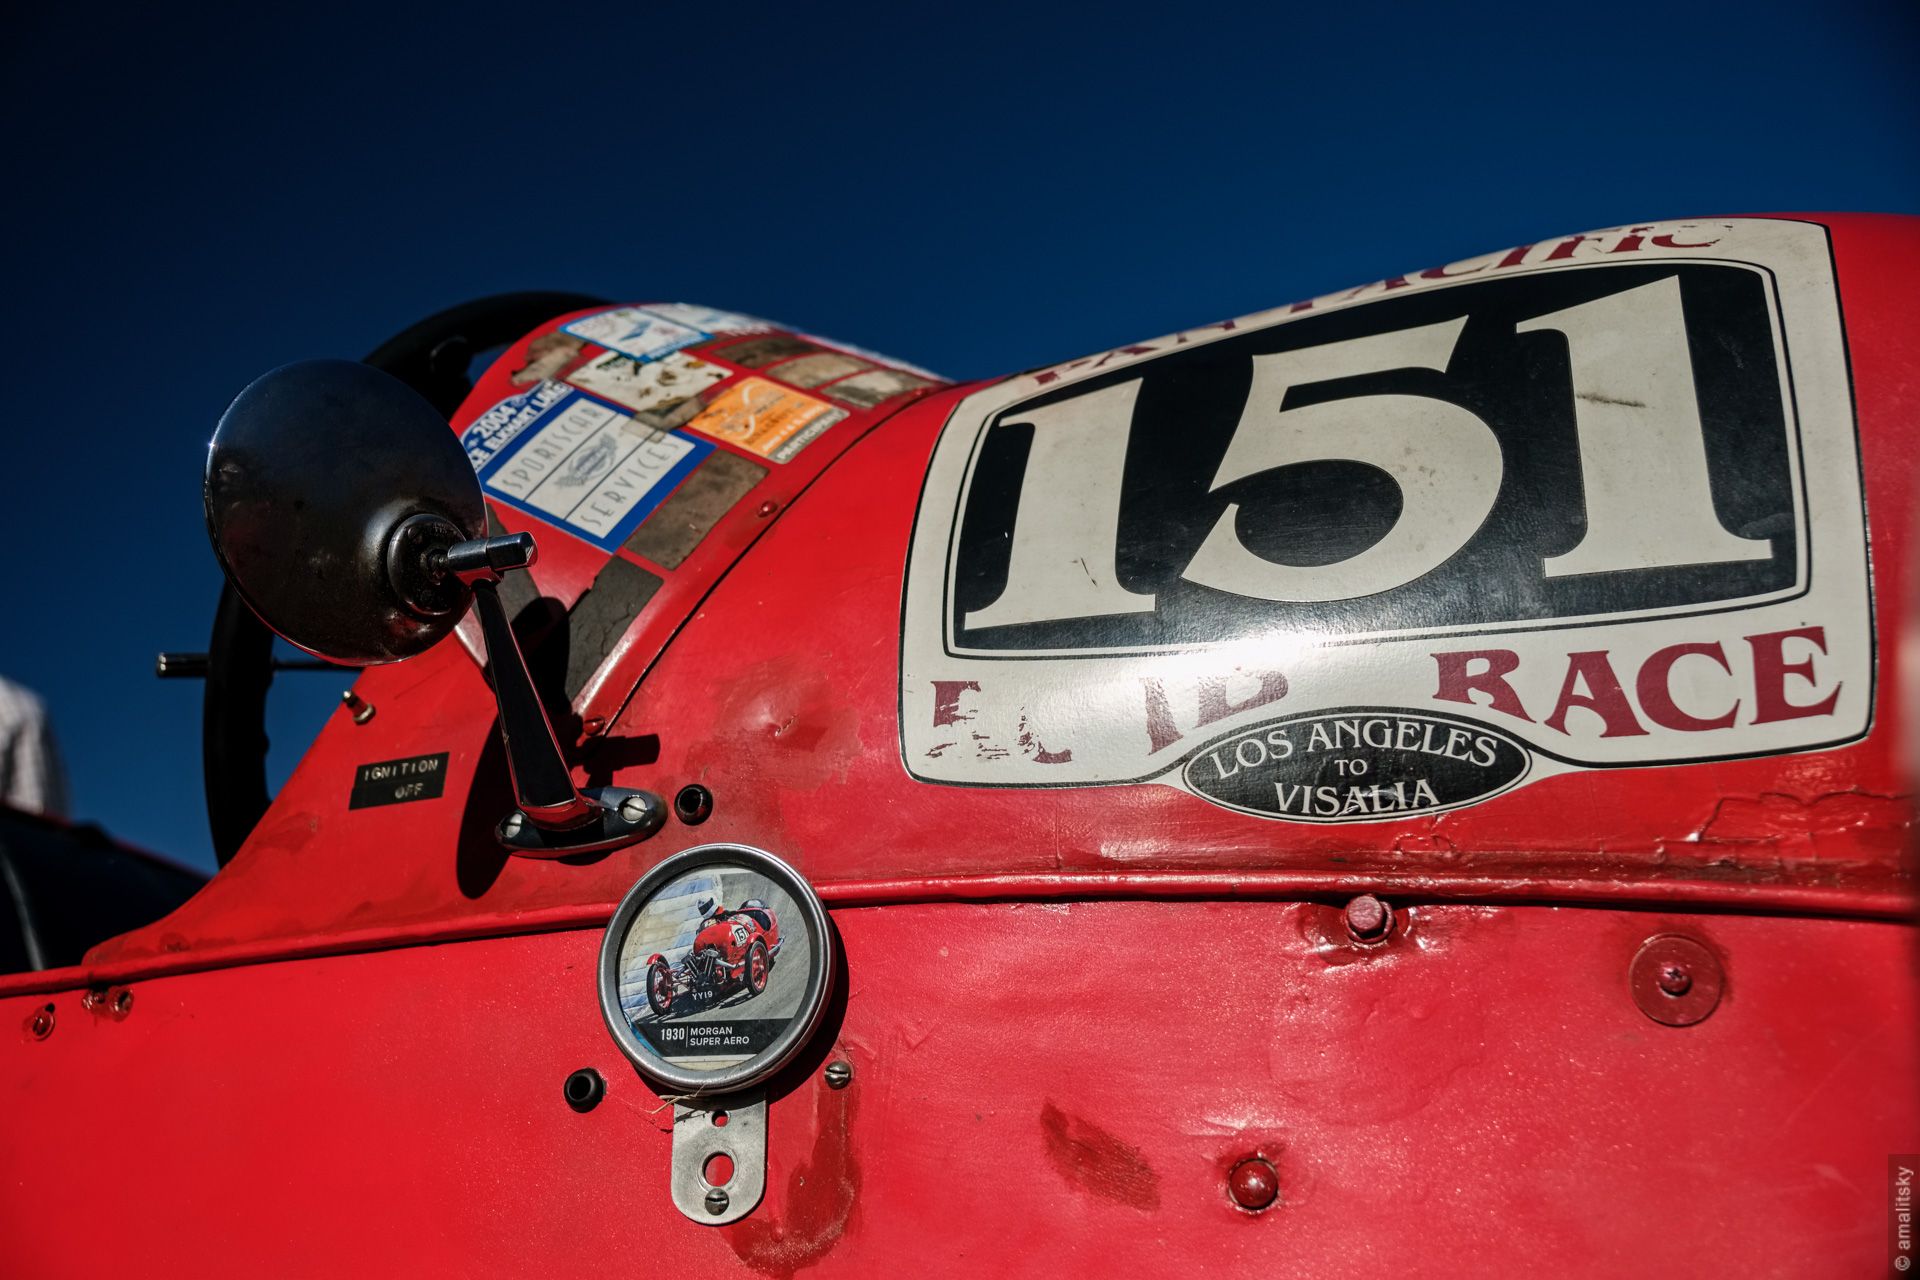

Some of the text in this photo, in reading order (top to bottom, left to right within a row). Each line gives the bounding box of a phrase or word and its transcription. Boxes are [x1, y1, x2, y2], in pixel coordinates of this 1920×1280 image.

[472, 404, 517, 440] 2004
[502, 406, 604, 490] SPORTSCAR
[963, 274, 1773, 630] 151
[580, 441, 680, 527] SERVICES
[1429, 625, 1843, 738] RACE
[1210, 719, 1498, 780] LOS ANGELES
[1334, 759, 1368, 776] TO
[364, 759, 439, 781] IGNITION
[394, 782, 424, 799] OFF
[1273, 779, 1441, 816] VISALIA
[660, 1027, 685, 1041] 1930
[690, 1026, 733, 1036] MORGAN
[690, 1035, 750, 1046] SUPER AERO
